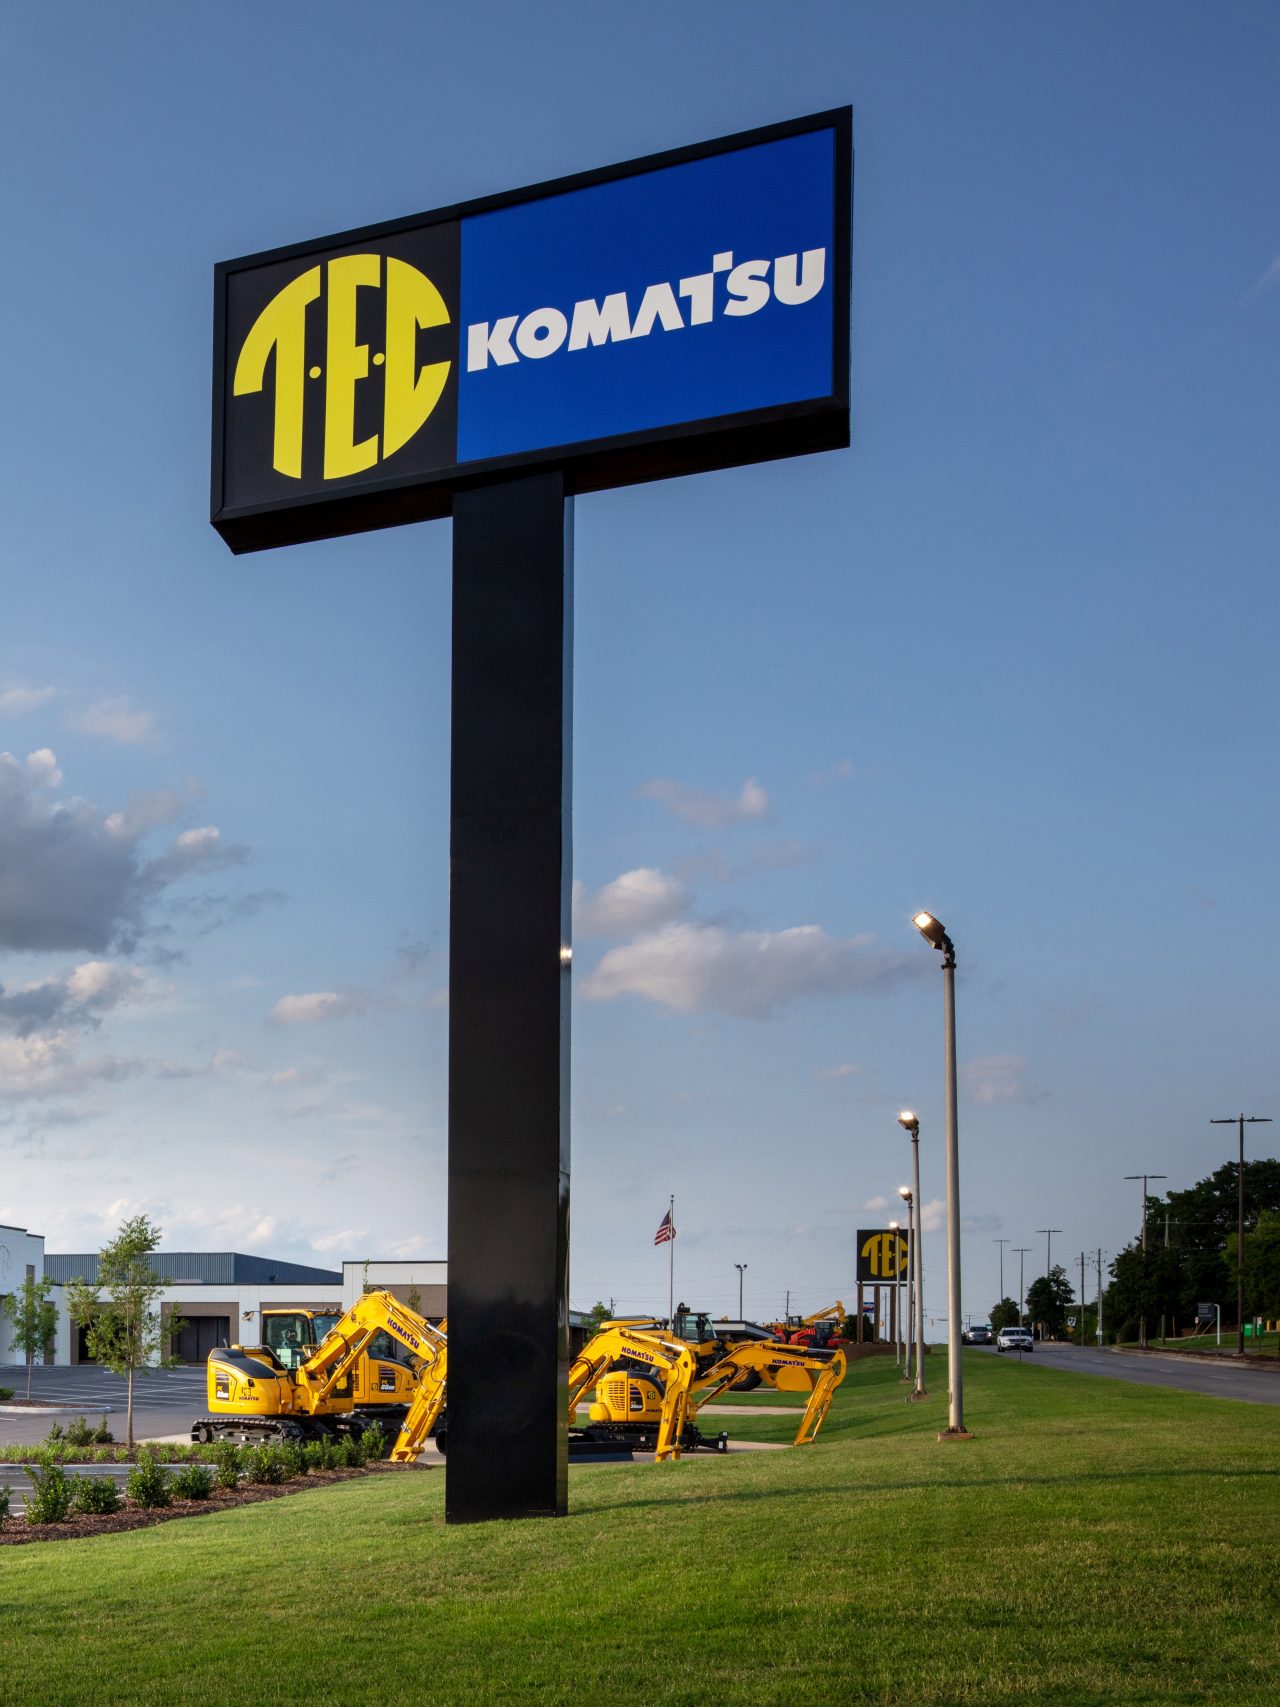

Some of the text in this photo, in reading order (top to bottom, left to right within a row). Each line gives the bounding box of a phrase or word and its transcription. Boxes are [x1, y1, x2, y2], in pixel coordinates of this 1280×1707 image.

[468, 248, 826, 373] KOMATSU
[387, 1317, 420, 1349] KOMATSU
[621, 1346, 654, 1362] KOMATSU
[772, 1358, 805, 1366] KOMATSU
